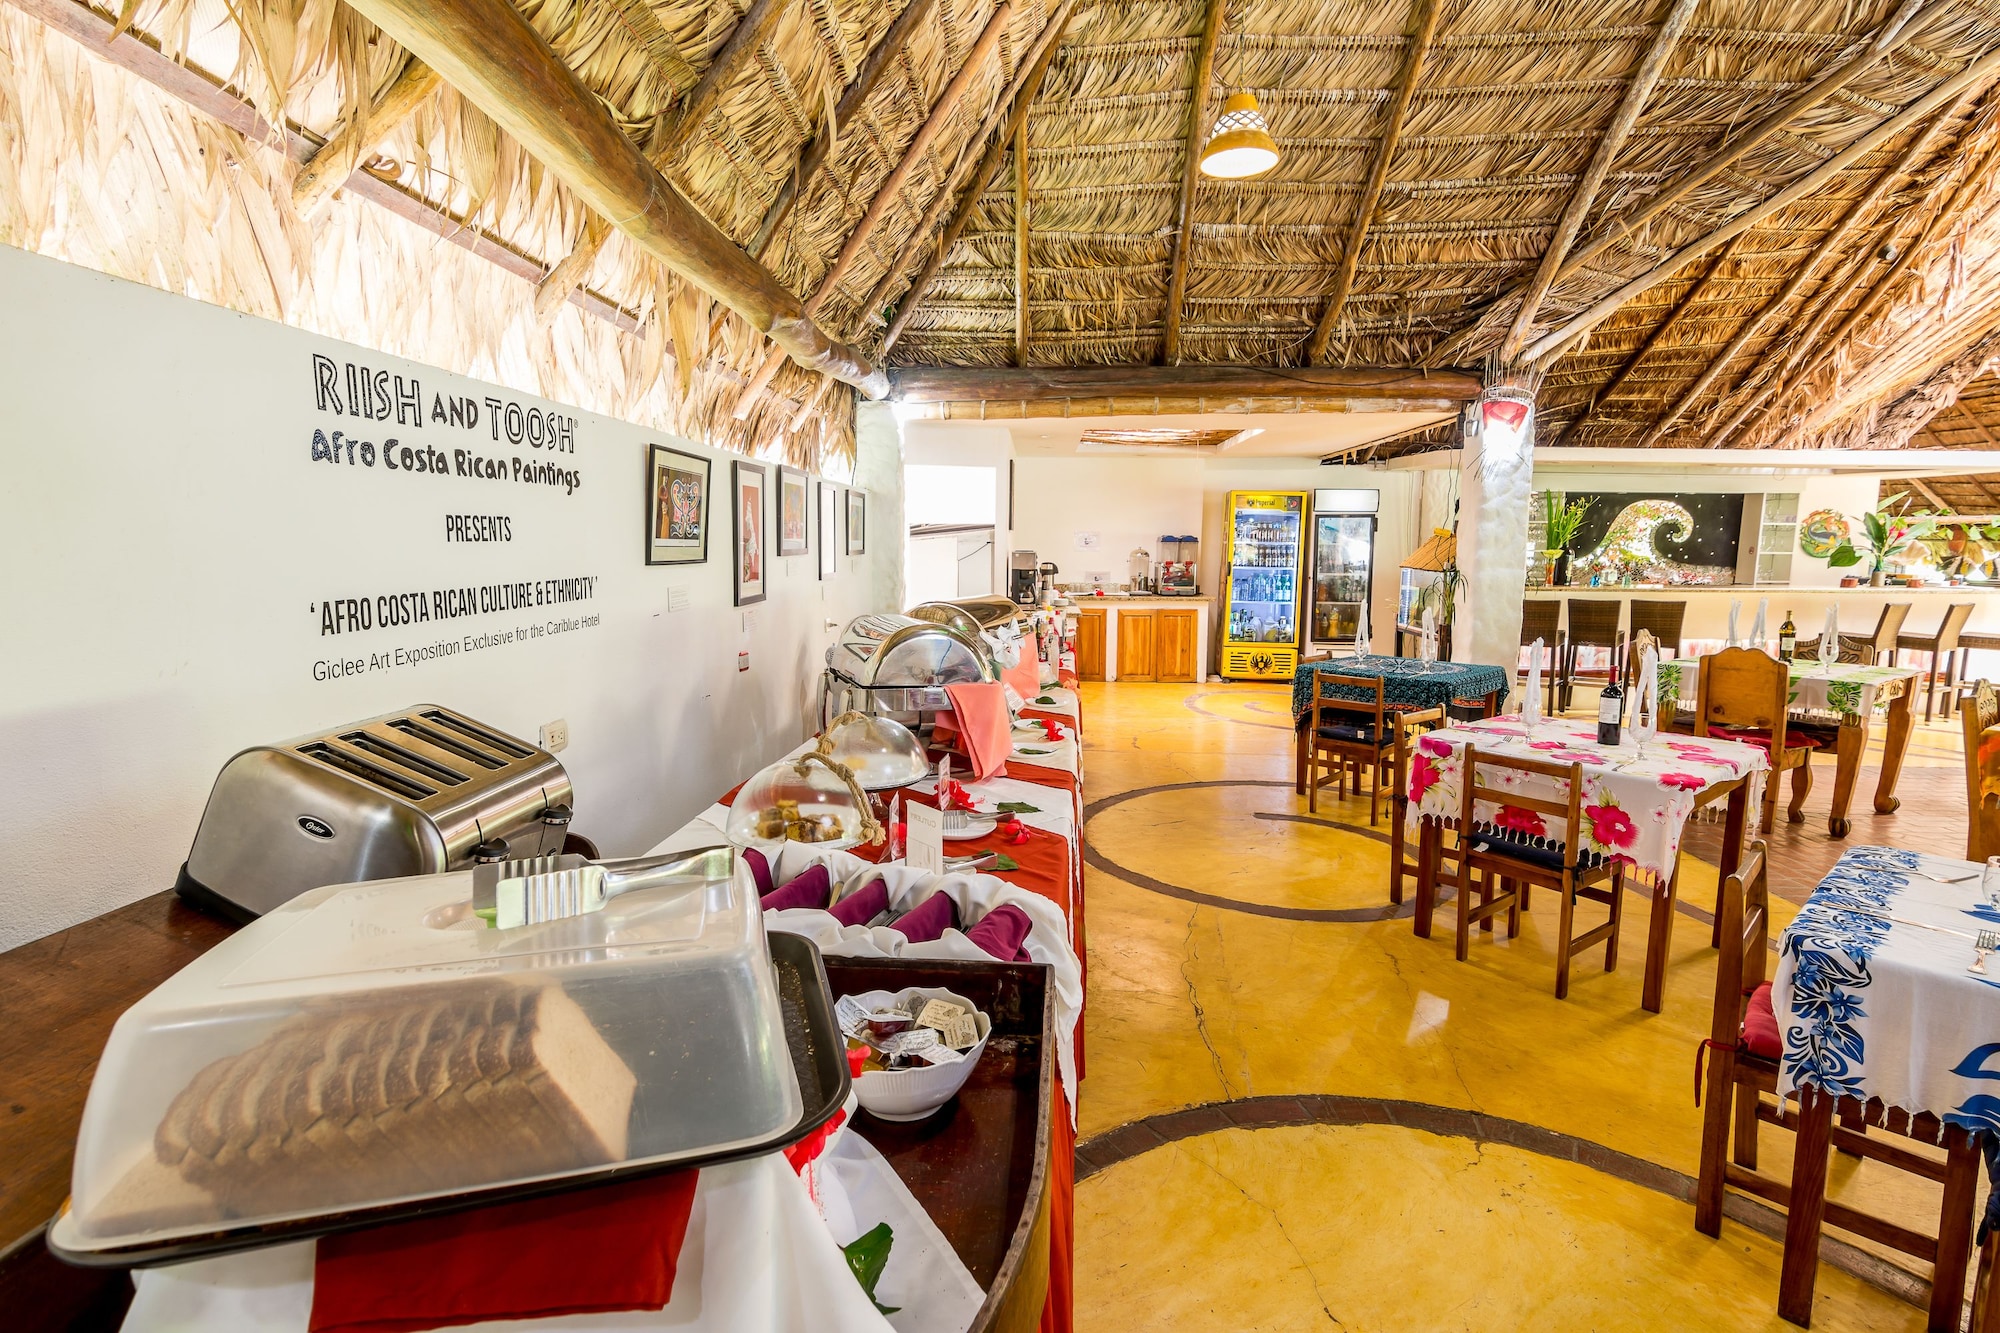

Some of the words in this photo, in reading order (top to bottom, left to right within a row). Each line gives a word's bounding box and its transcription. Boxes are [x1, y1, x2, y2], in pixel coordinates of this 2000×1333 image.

[312, 353, 422, 428] RIISH
[431, 391, 479, 430] AND
[311, 428, 376, 468] Afro
[383, 438, 450, 475] Costa
[454, 448, 508, 481] Rican
[512, 456, 581, 496] Paintings
[446, 514, 512, 542] PRESENTS
[377, 593, 430, 628] COSTA
[433, 587, 477, 620] RICAN
[480, 582, 533, 614] CULTURE
[536, 581, 543, 606] &
[313, 657, 365, 681] Giclee
[369, 651, 391, 671] Art
[395, 639, 460, 667] Exposition
[463, 629, 513, 652] Exclusive
[516, 626, 528, 641] for
[530, 623, 544, 639] the
[546, 618, 580, 636] Cariblue
[581, 613, 600, 629] Hotel
[305, 821, 326, 833] Oster
